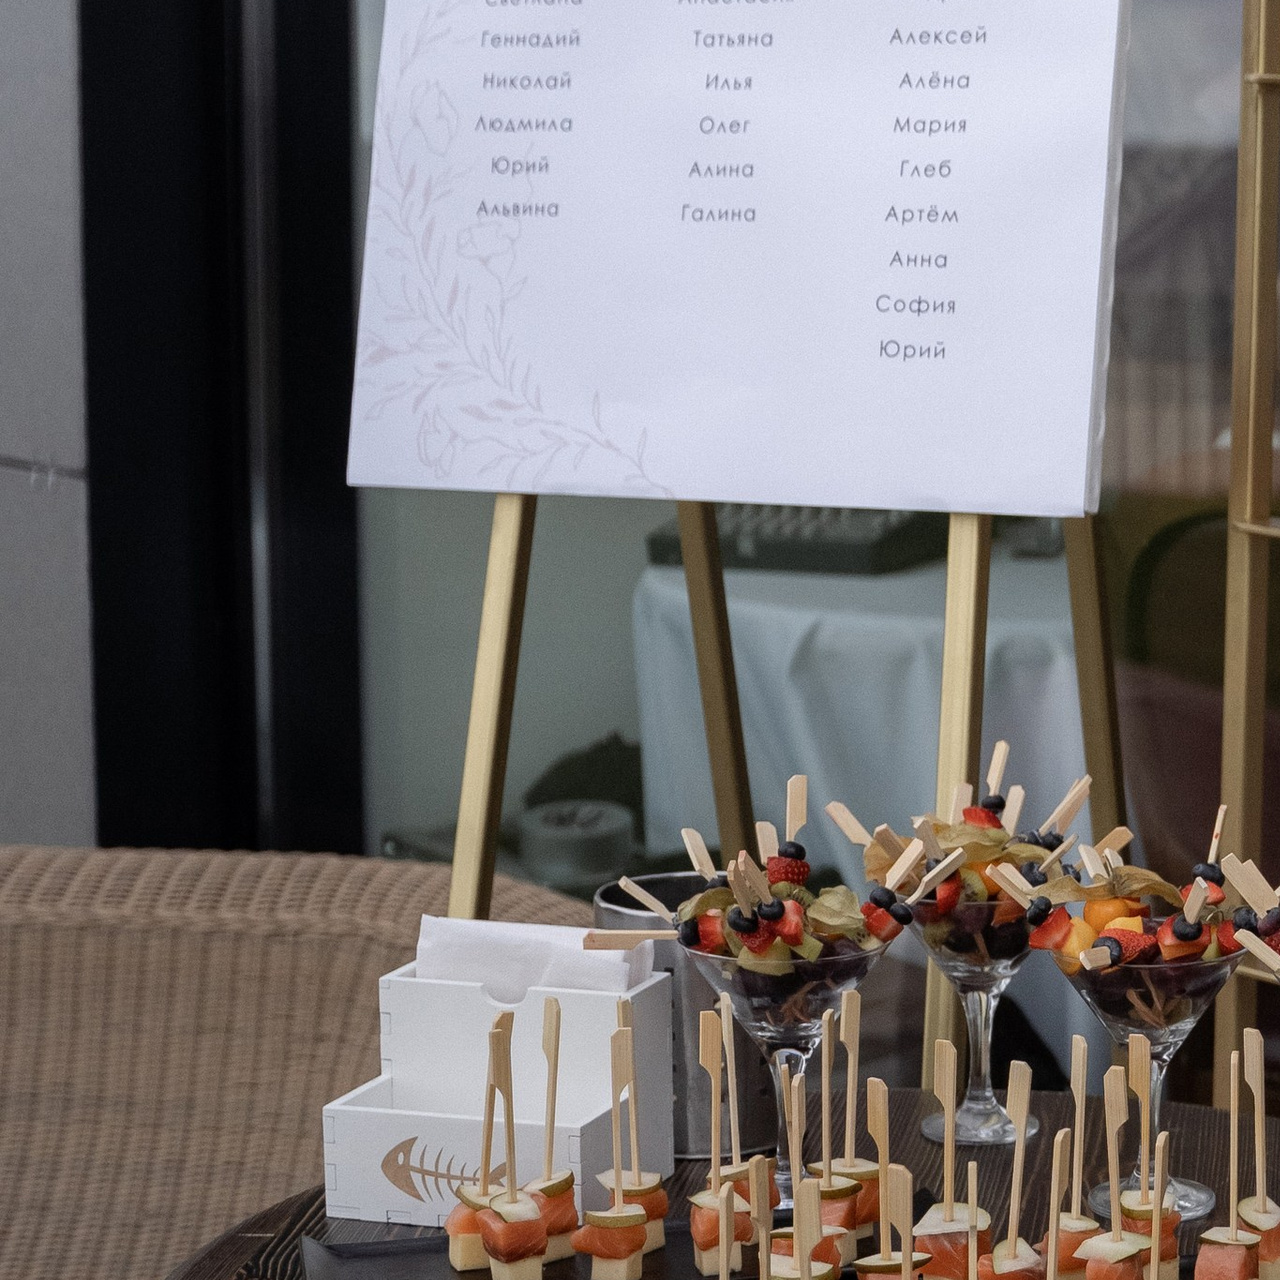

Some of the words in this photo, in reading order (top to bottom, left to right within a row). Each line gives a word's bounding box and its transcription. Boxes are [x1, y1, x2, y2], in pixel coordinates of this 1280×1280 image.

[480, 28, 582, 49] Геннадий
[693, 29, 775, 49] Татьяна
[889, 25, 988, 46] Алексей
[482, 71, 573, 91] Николай
[704, 73, 754, 91] Илья
[898, 71, 971, 90] Алёна
[474, 114, 574, 134] Людмила
[698, 115, 750, 136] Олег
[892, 116, 968, 137] Мария
[490, 155, 550, 178] Юрий
[688, 160, 755, 179] Алина
[899, 158, 953, 179] Глеб
[476, 199, 560, 218] Альвина
[680, 202, 757, 223] Галина
[884, 204, 960, 226] Артём
[888, 250, 949, 270] Анна
[874, 293, 957, 317] София
[878, 338, 947, 362] Юрий
